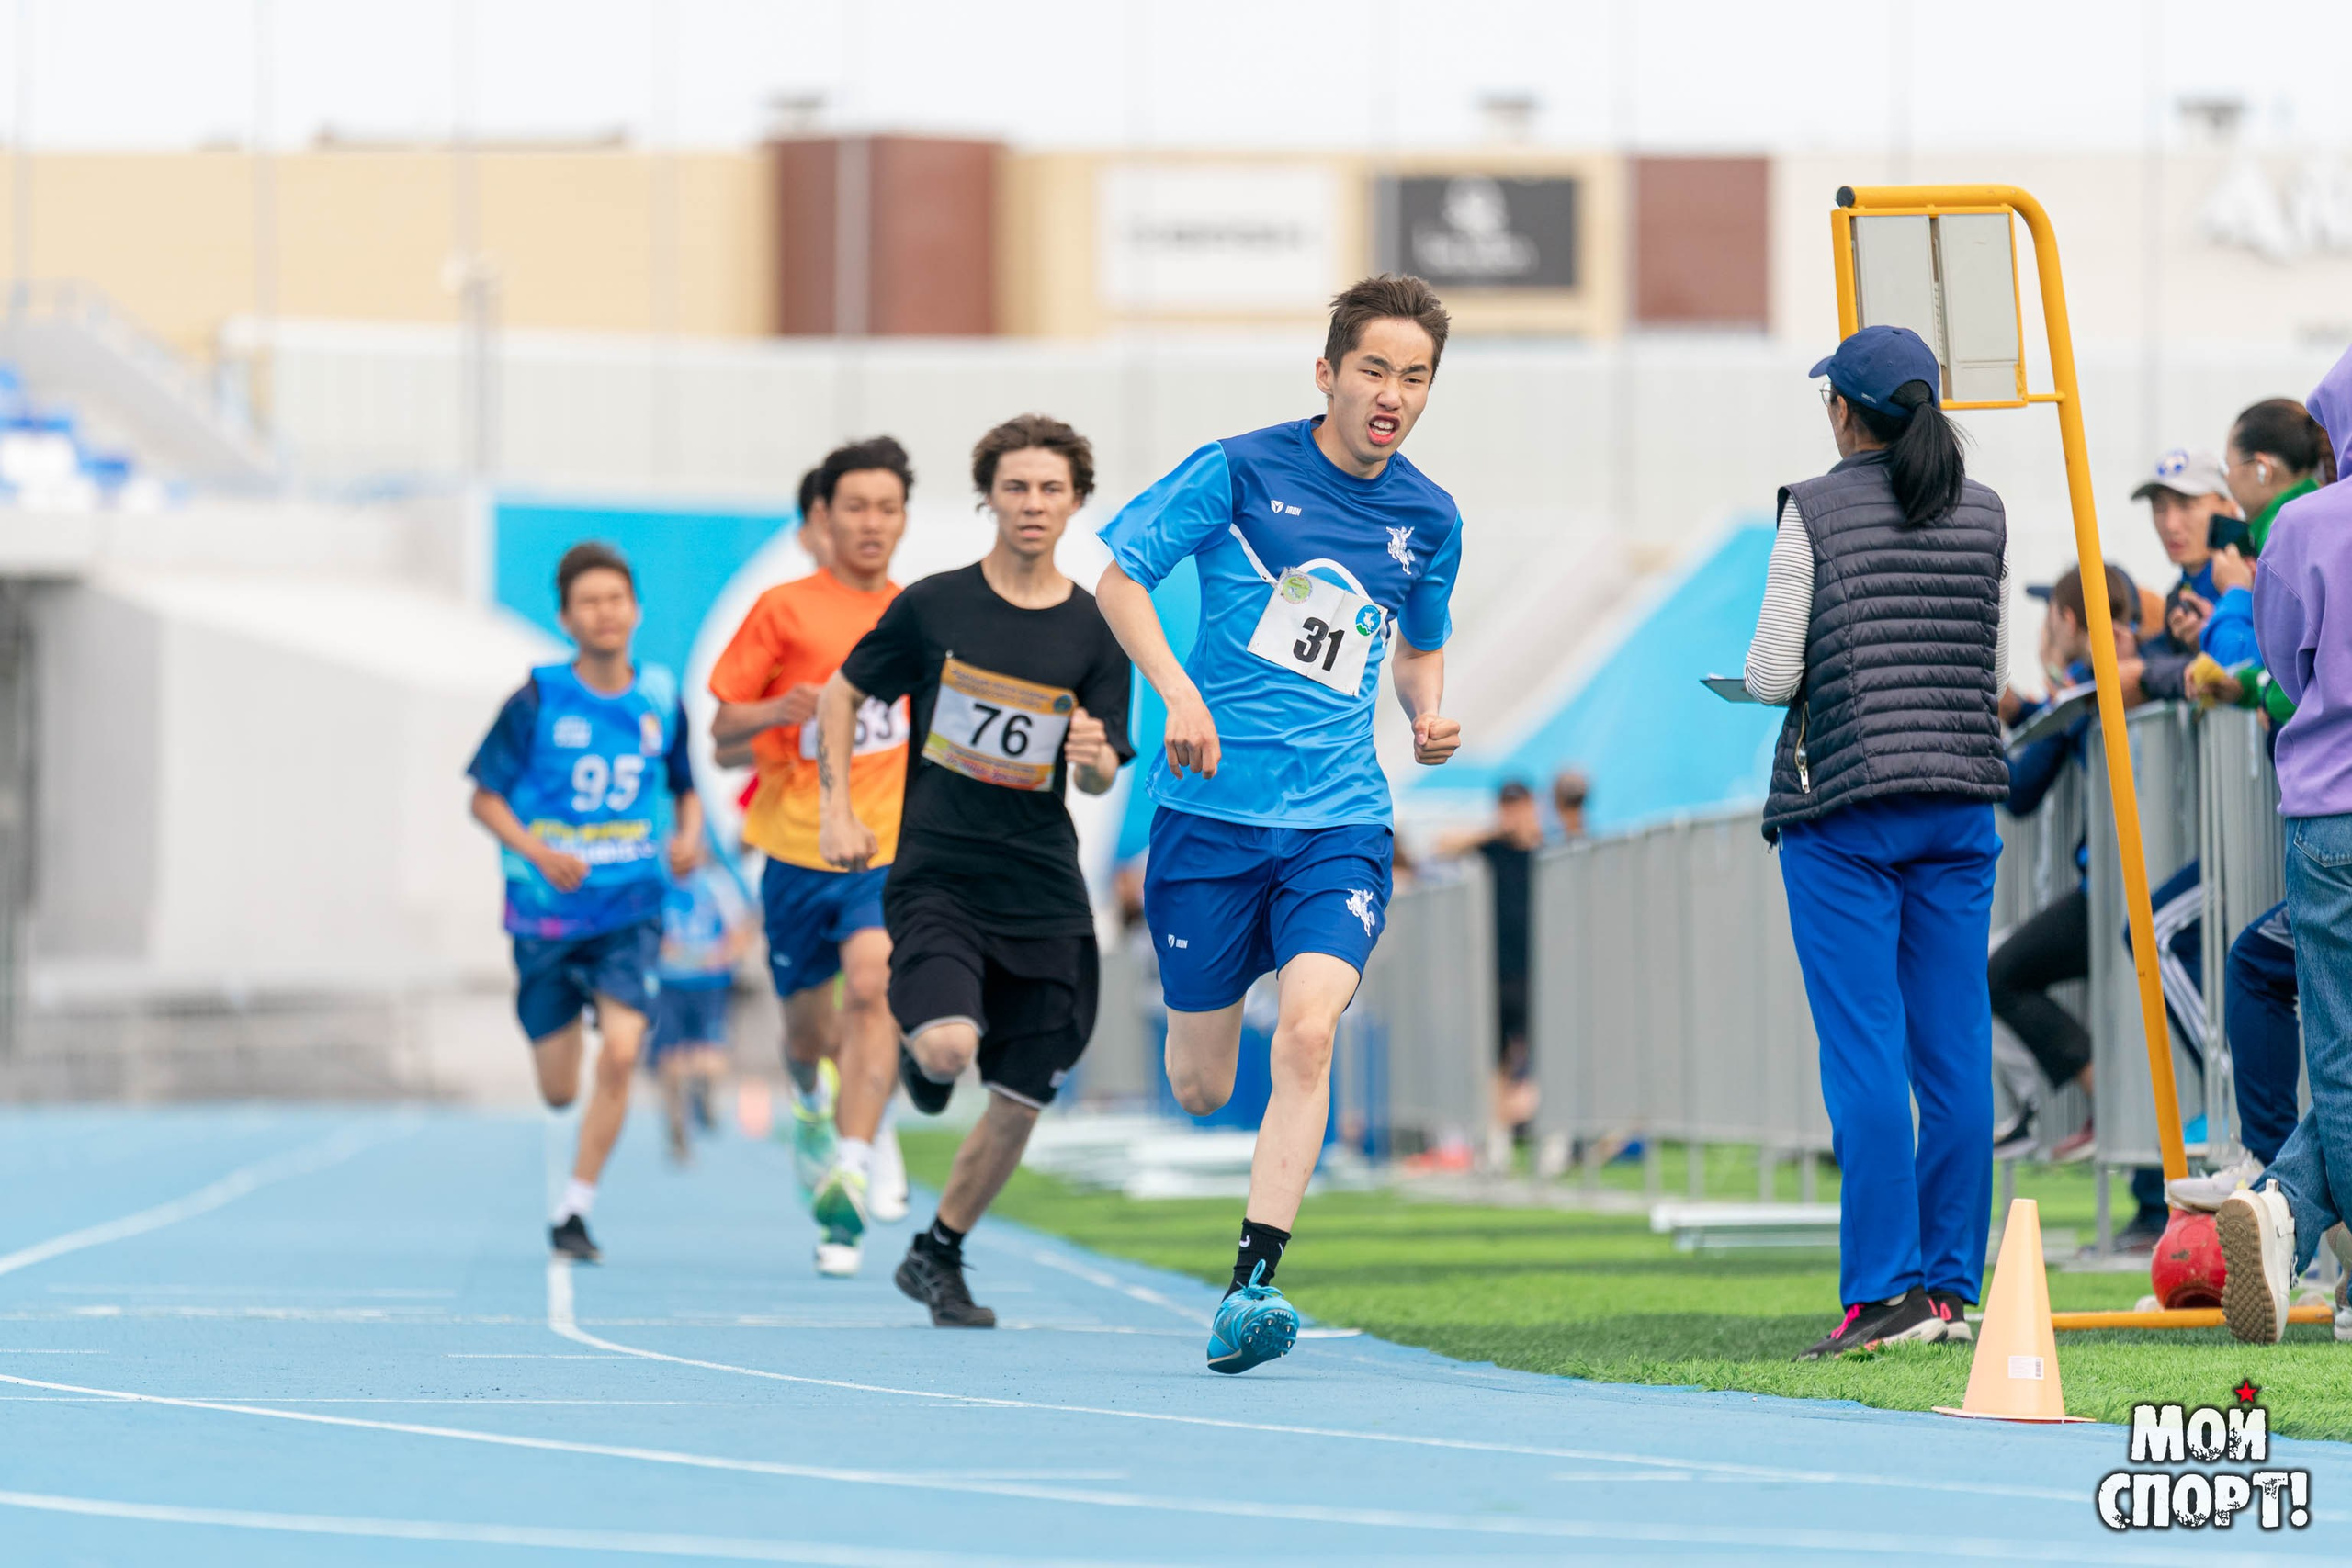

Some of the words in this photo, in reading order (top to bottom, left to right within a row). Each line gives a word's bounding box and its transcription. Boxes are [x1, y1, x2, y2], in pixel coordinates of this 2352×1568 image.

[1293, 616, 1345, 672] 31
[969, 702, 1033, 757] 76
[571, 753, 646, 812] 95
